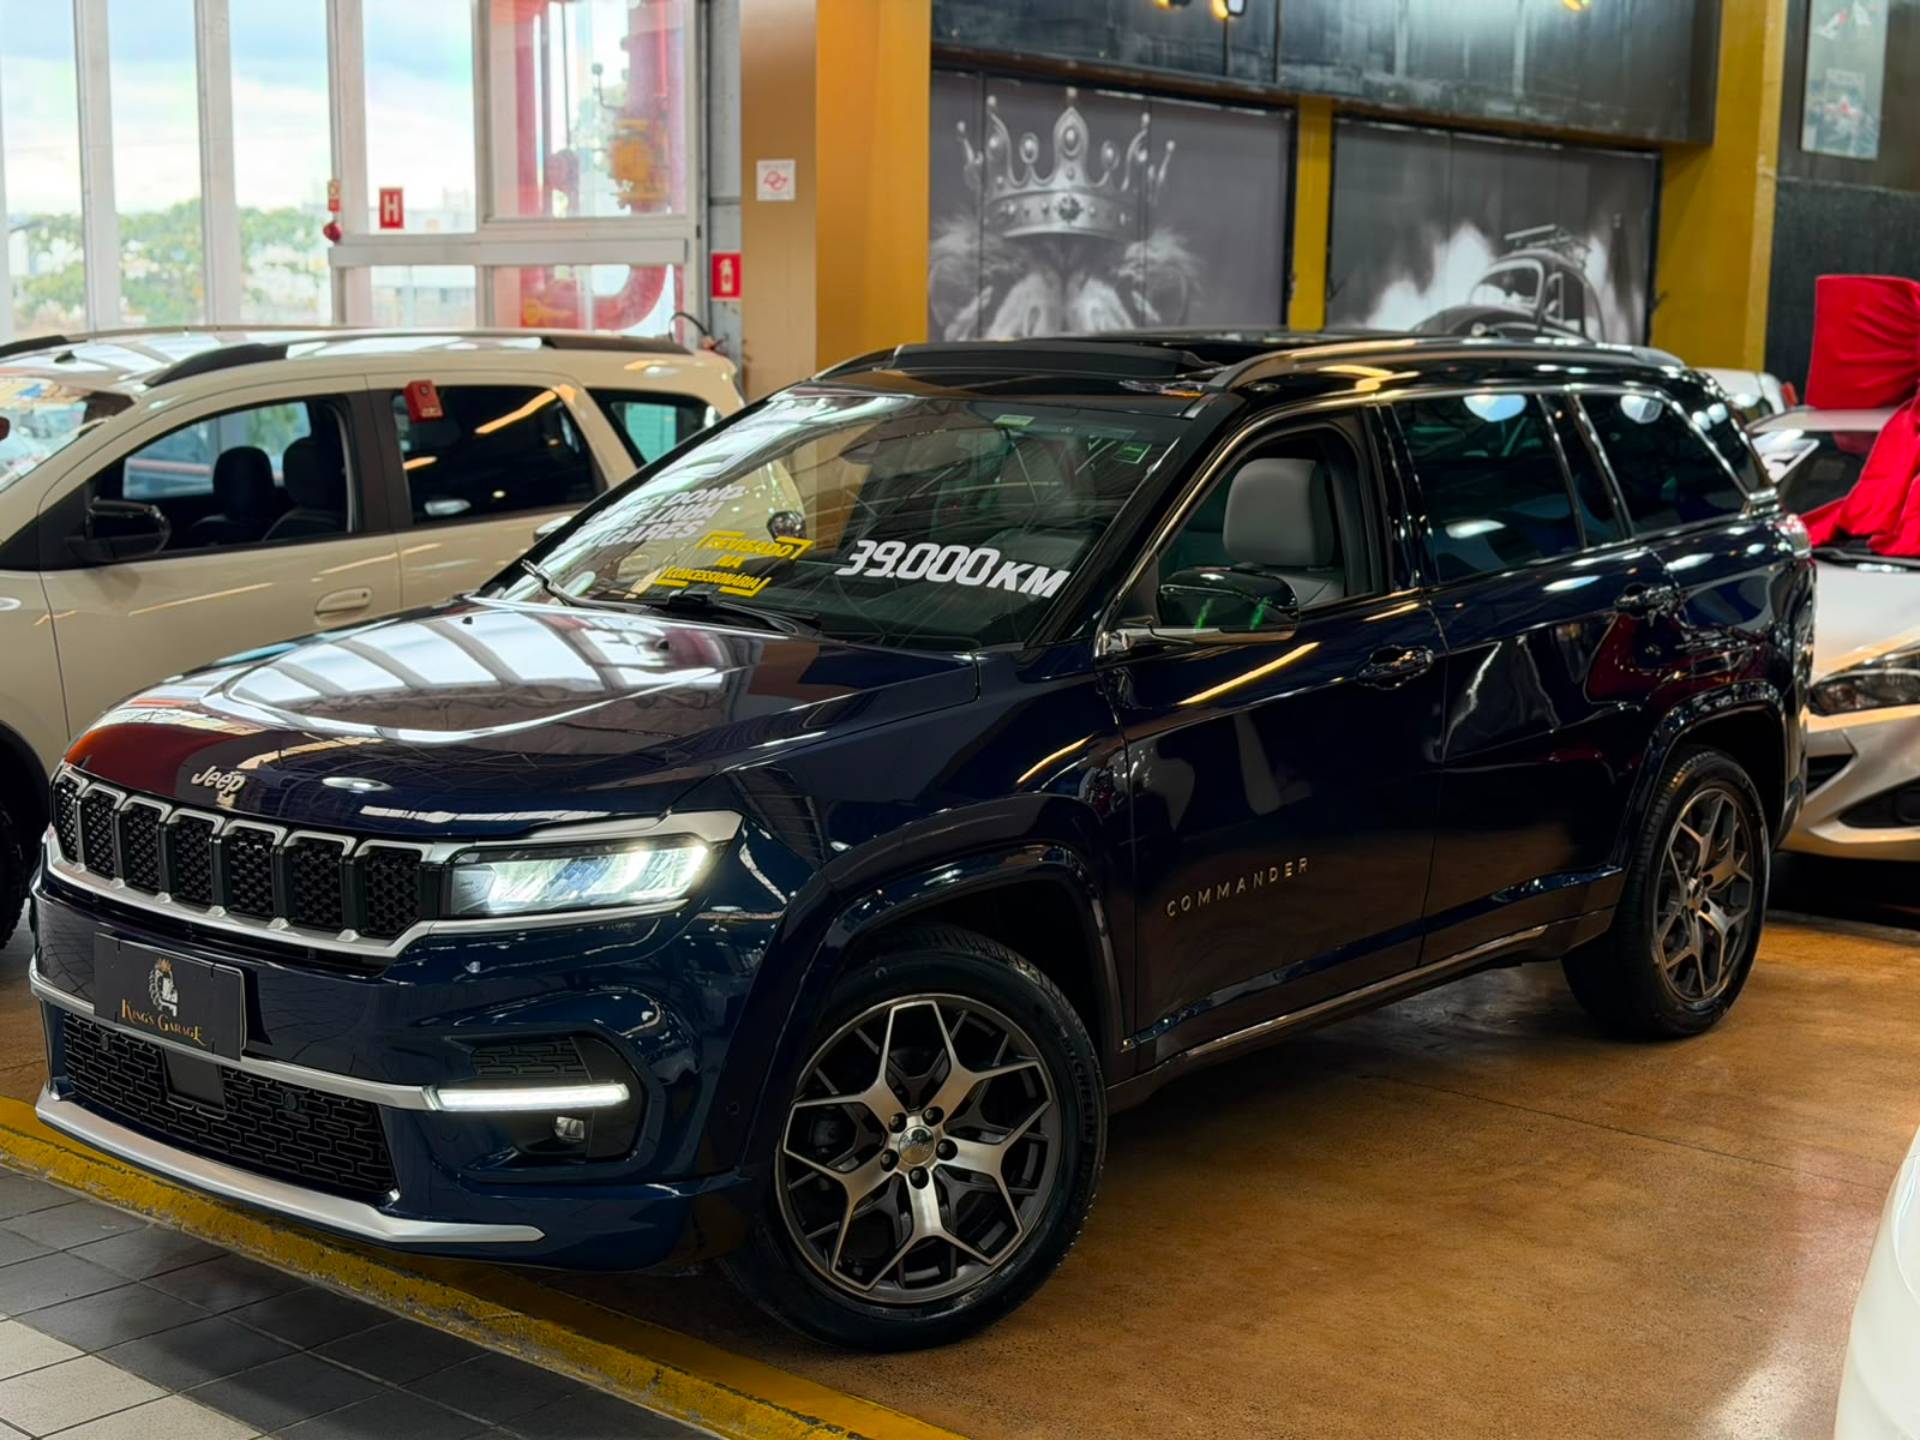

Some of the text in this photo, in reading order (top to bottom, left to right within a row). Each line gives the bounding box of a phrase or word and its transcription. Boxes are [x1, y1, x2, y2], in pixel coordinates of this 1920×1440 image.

[383, 192, 400, 224] H
[580, 519, 706, 549] UGARES
[191, 766, 247, 796] Jeep
[1166, 857, 1308, 917] COMMANDER
[157, 1014, 207, 1046] GARAGE
